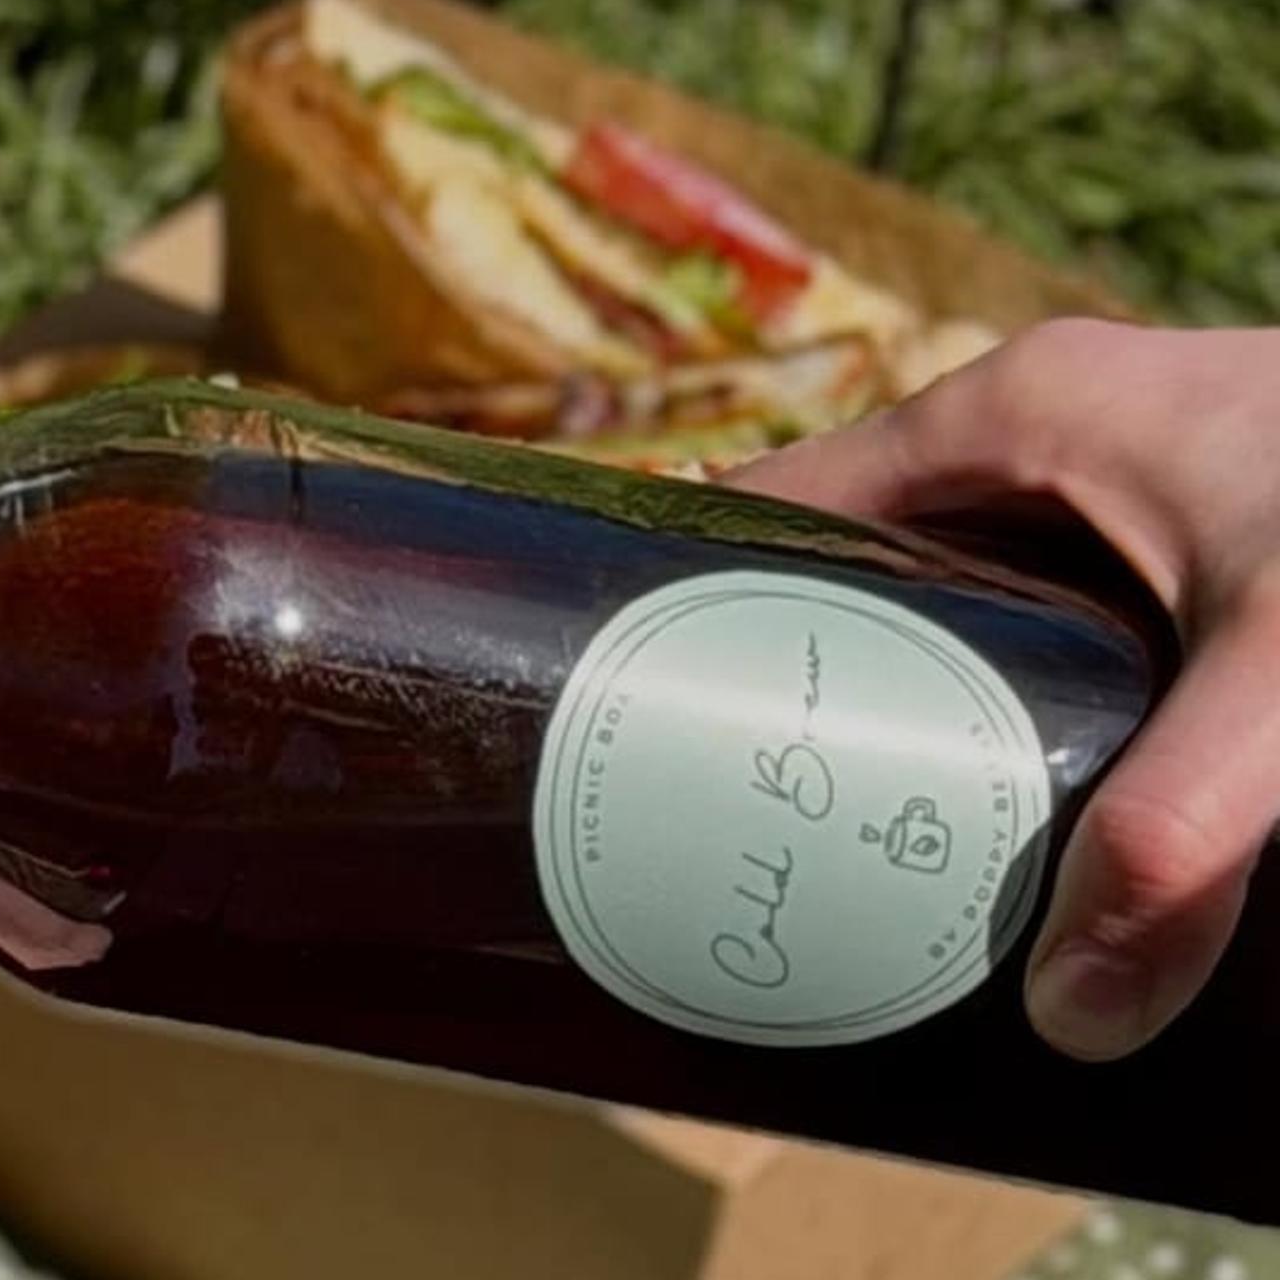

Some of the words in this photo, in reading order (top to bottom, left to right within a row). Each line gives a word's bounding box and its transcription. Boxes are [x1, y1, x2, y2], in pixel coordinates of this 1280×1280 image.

[582, 757, 605, 863] PICNIC
[709, 845, 793, 988] Cold
[751, 631, 835, 821] Brew
[928, 928, 957, 959] BY
[963, 828, 1008, 920] POPPY
